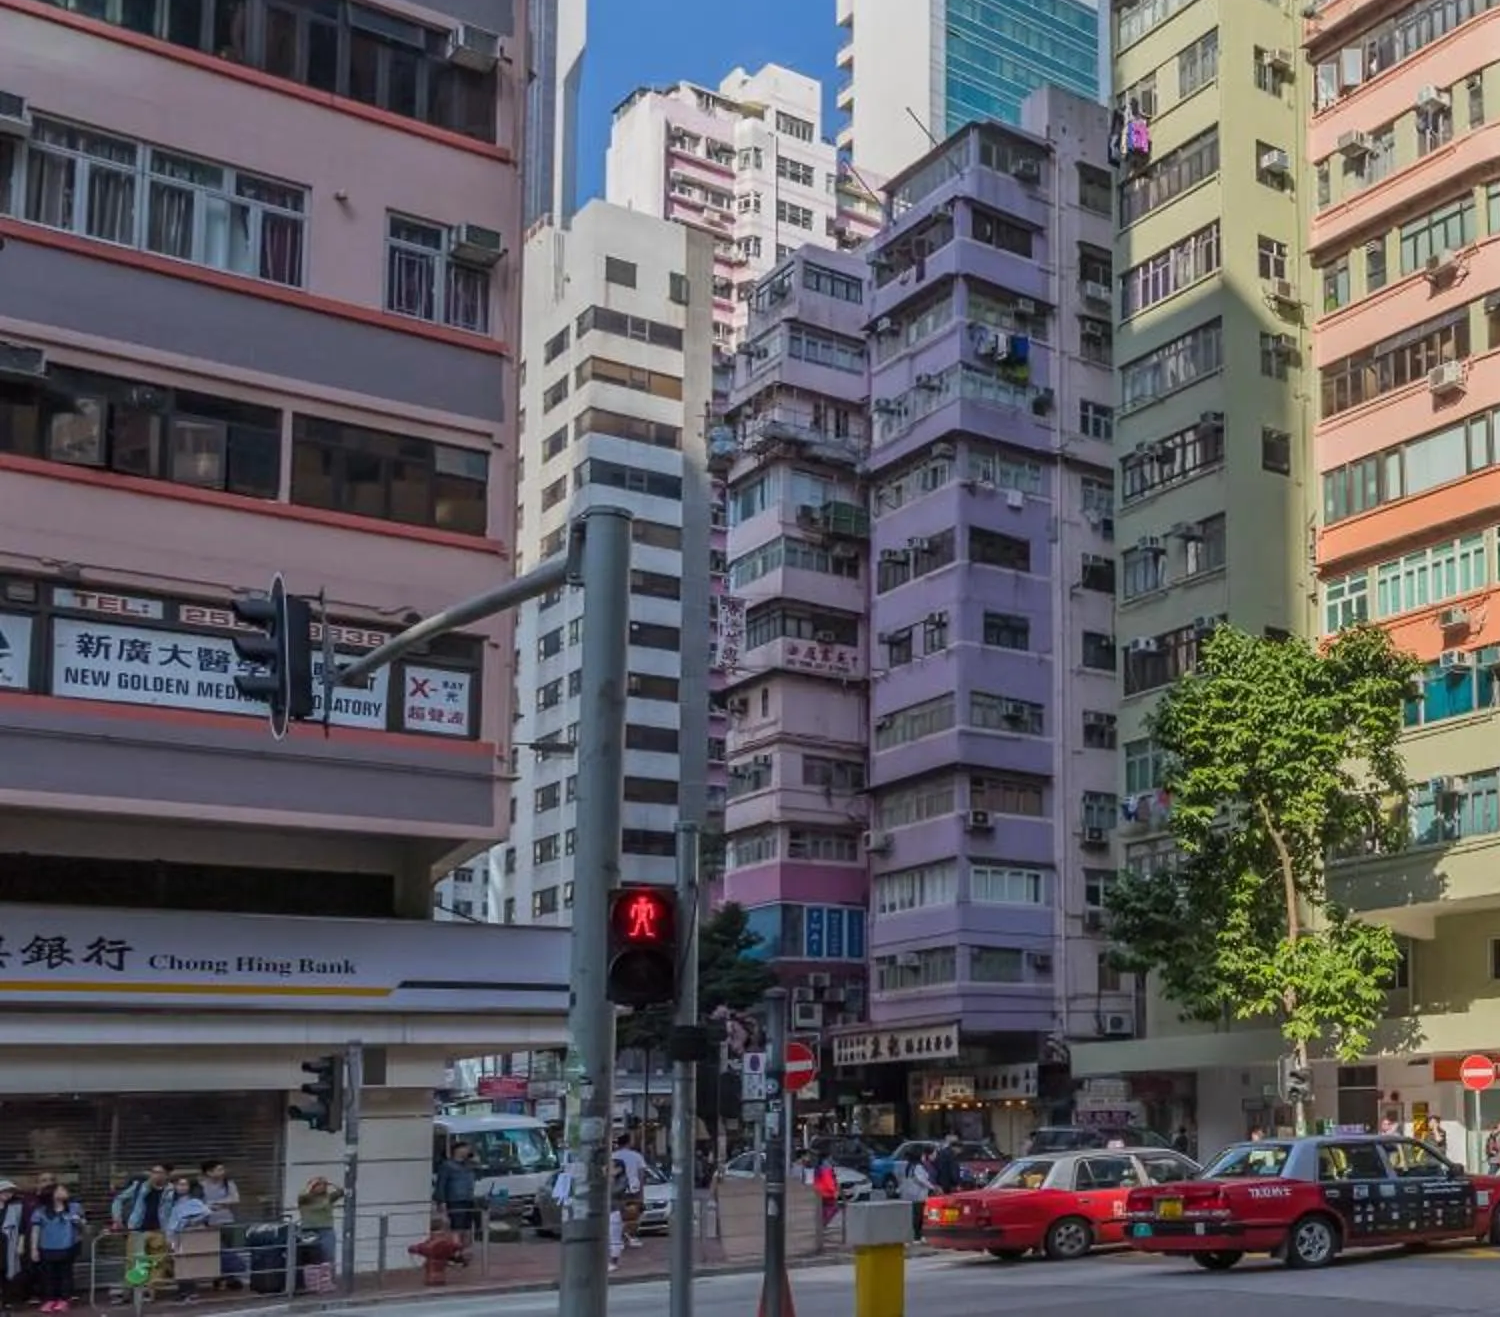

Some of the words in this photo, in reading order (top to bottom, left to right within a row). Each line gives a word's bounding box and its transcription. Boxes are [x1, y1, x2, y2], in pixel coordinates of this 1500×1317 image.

[73, 591, 150, 614] TEL:
[64, 666, 111, 688] NEW
[117, 672, 189, 695] GOLDEN
[149, 953, 228, 974] Chong
[235, 956, 292, 977] Hing
[300, 957, 357, 976] Bank
